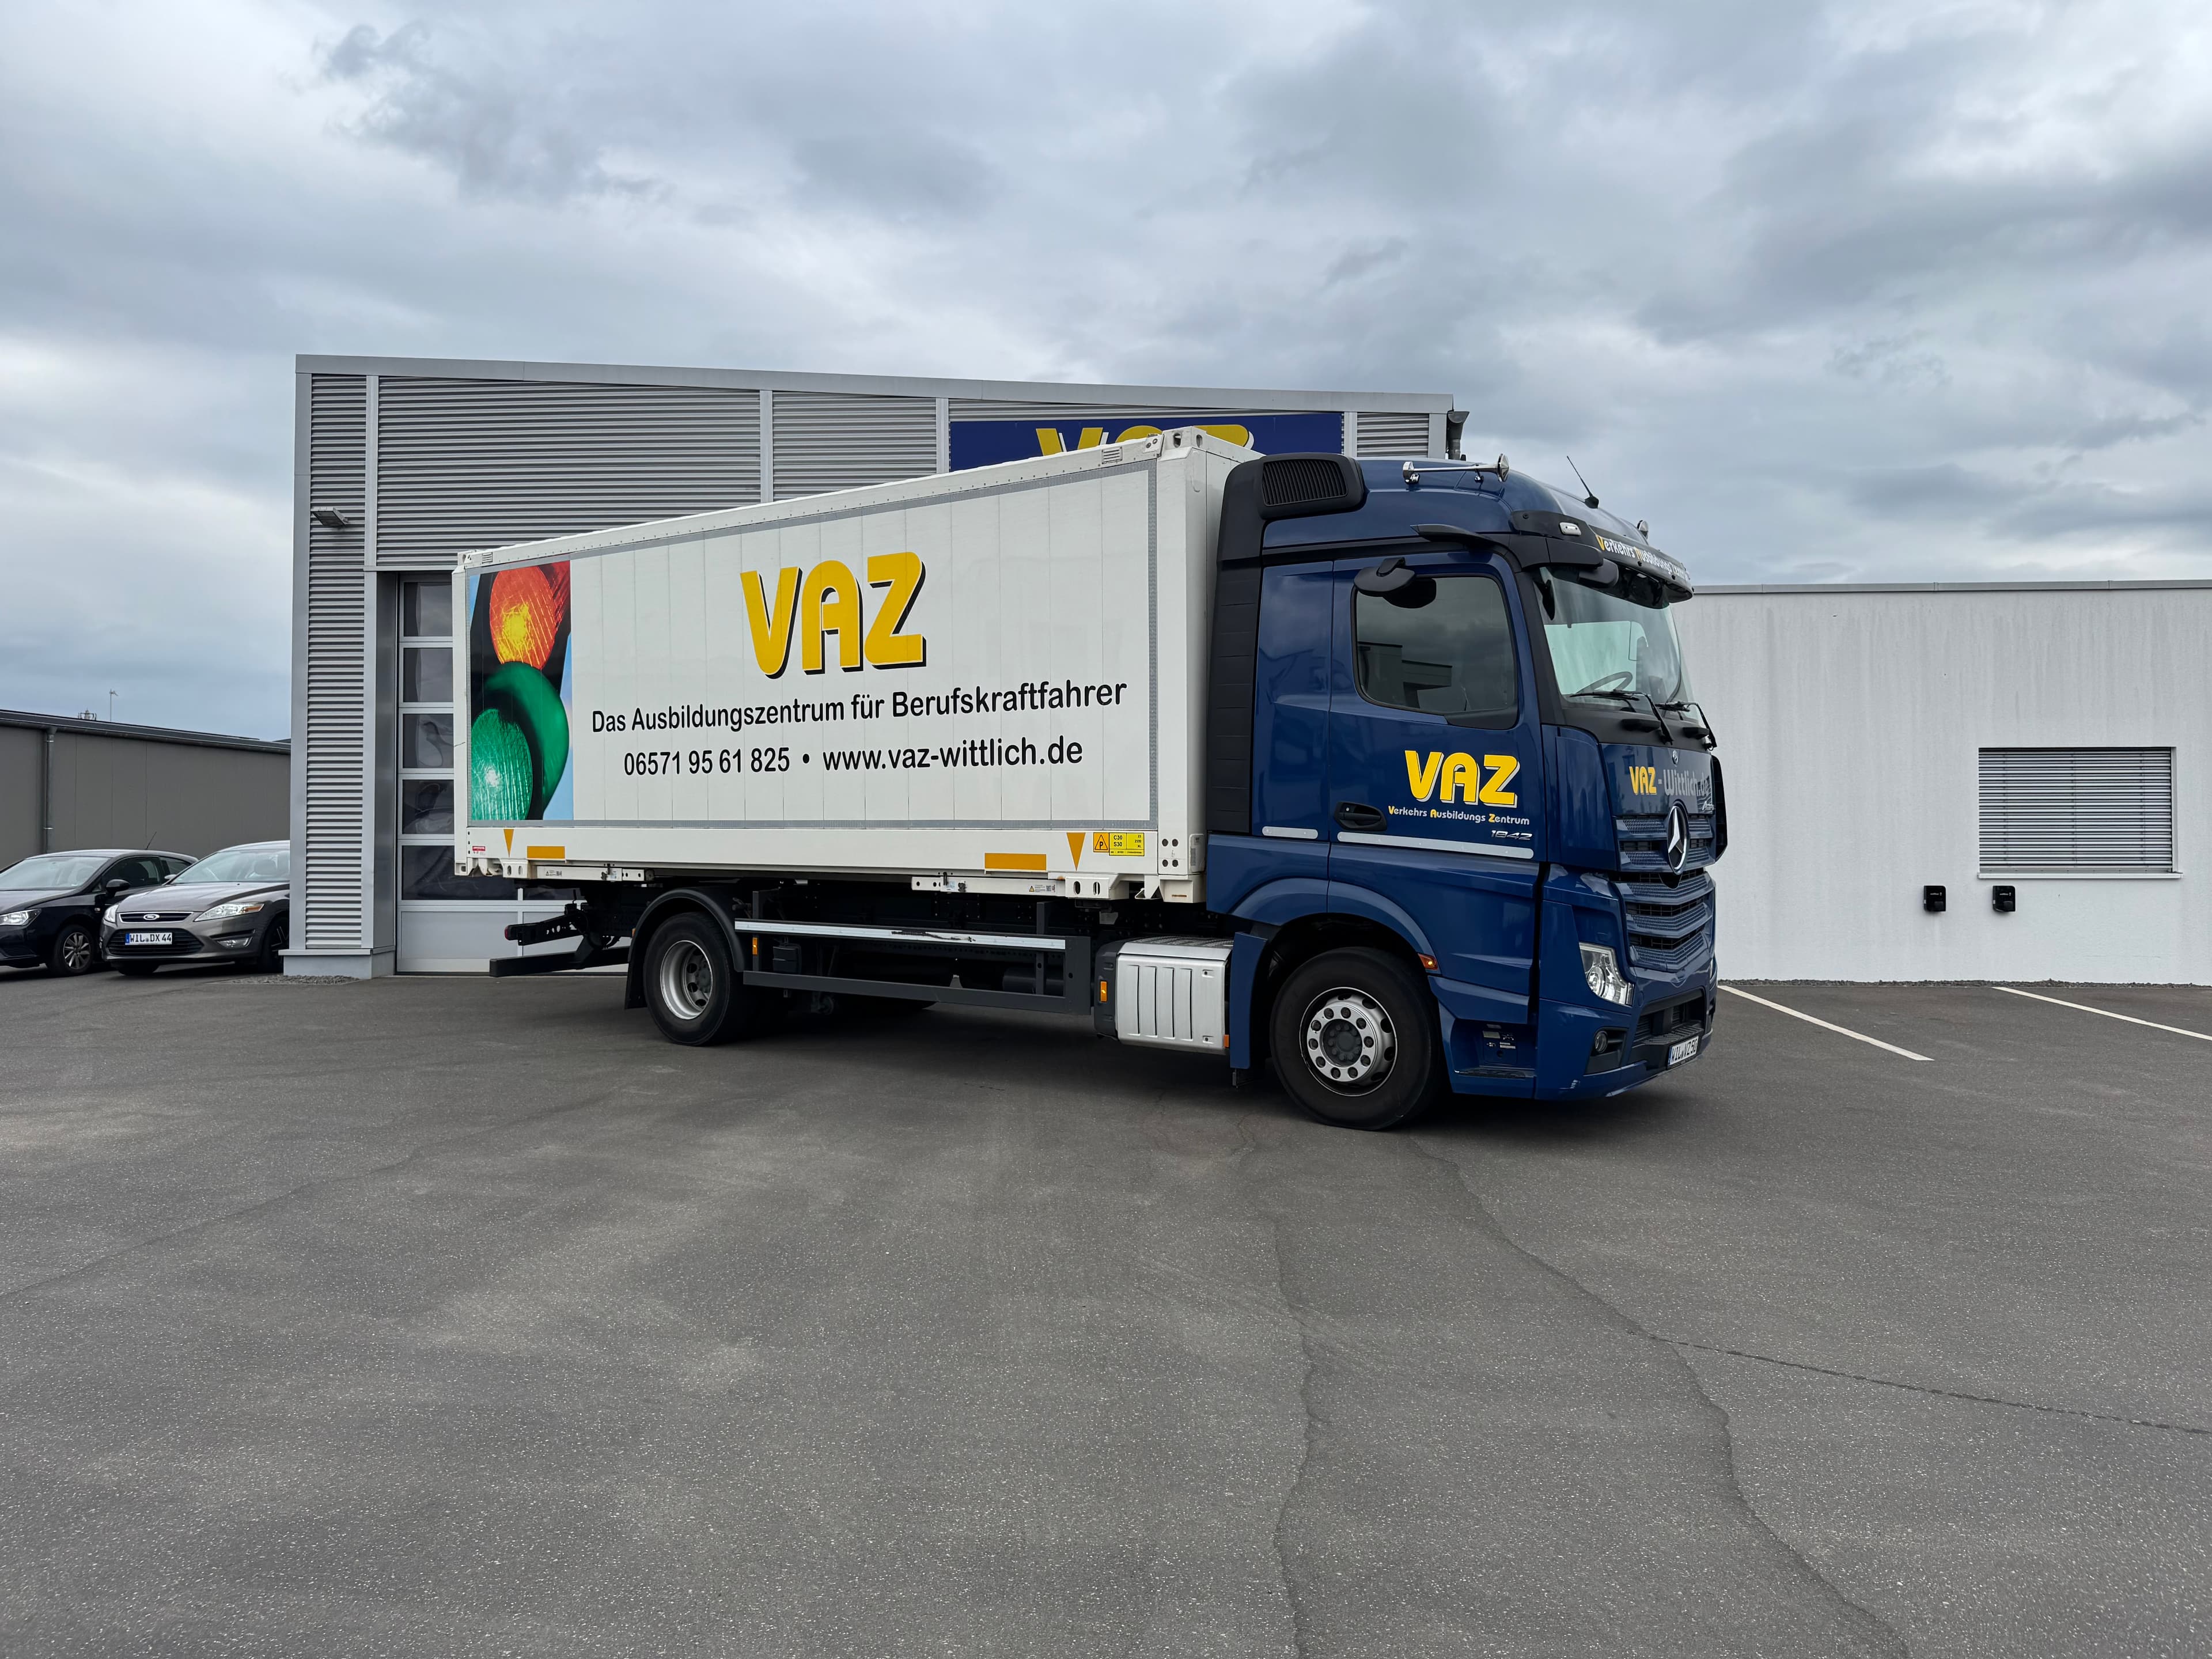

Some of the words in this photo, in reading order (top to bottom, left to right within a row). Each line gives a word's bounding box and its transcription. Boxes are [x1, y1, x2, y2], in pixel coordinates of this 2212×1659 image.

[1596, 535, 1635, 558] Verkehrs
[741, 552, 926, 679] VAZ
[592, 710, 626, 733] Das
[631, 694, 844, 732] Ausbildungszentrum
[850, 694, 885, 720] für
[892, 679, 1127, 717] Berufskraftfahrer
[624, 751, 680, 776] 06571
[688, 750, 713, 774] 95
[719, 748, 741, 774] 61
[751, 747, 790, 772] 825
[823, 735, 1082, 771] www.vaz-wittlich.de
[1405, 751, 1520, 808] VAZ
[1388, 805, 1427, 817] Verkehrs
[1430, 808, 1486, 823] Ausbildungs
[1488, 813, 1530, 825] Zentrum
[1491, 830, 1533, 840] 1842
[130, 934, 145, 942] WIL
[150, 934, 160, 942] DX
[162, 934, 172, 942] 44
